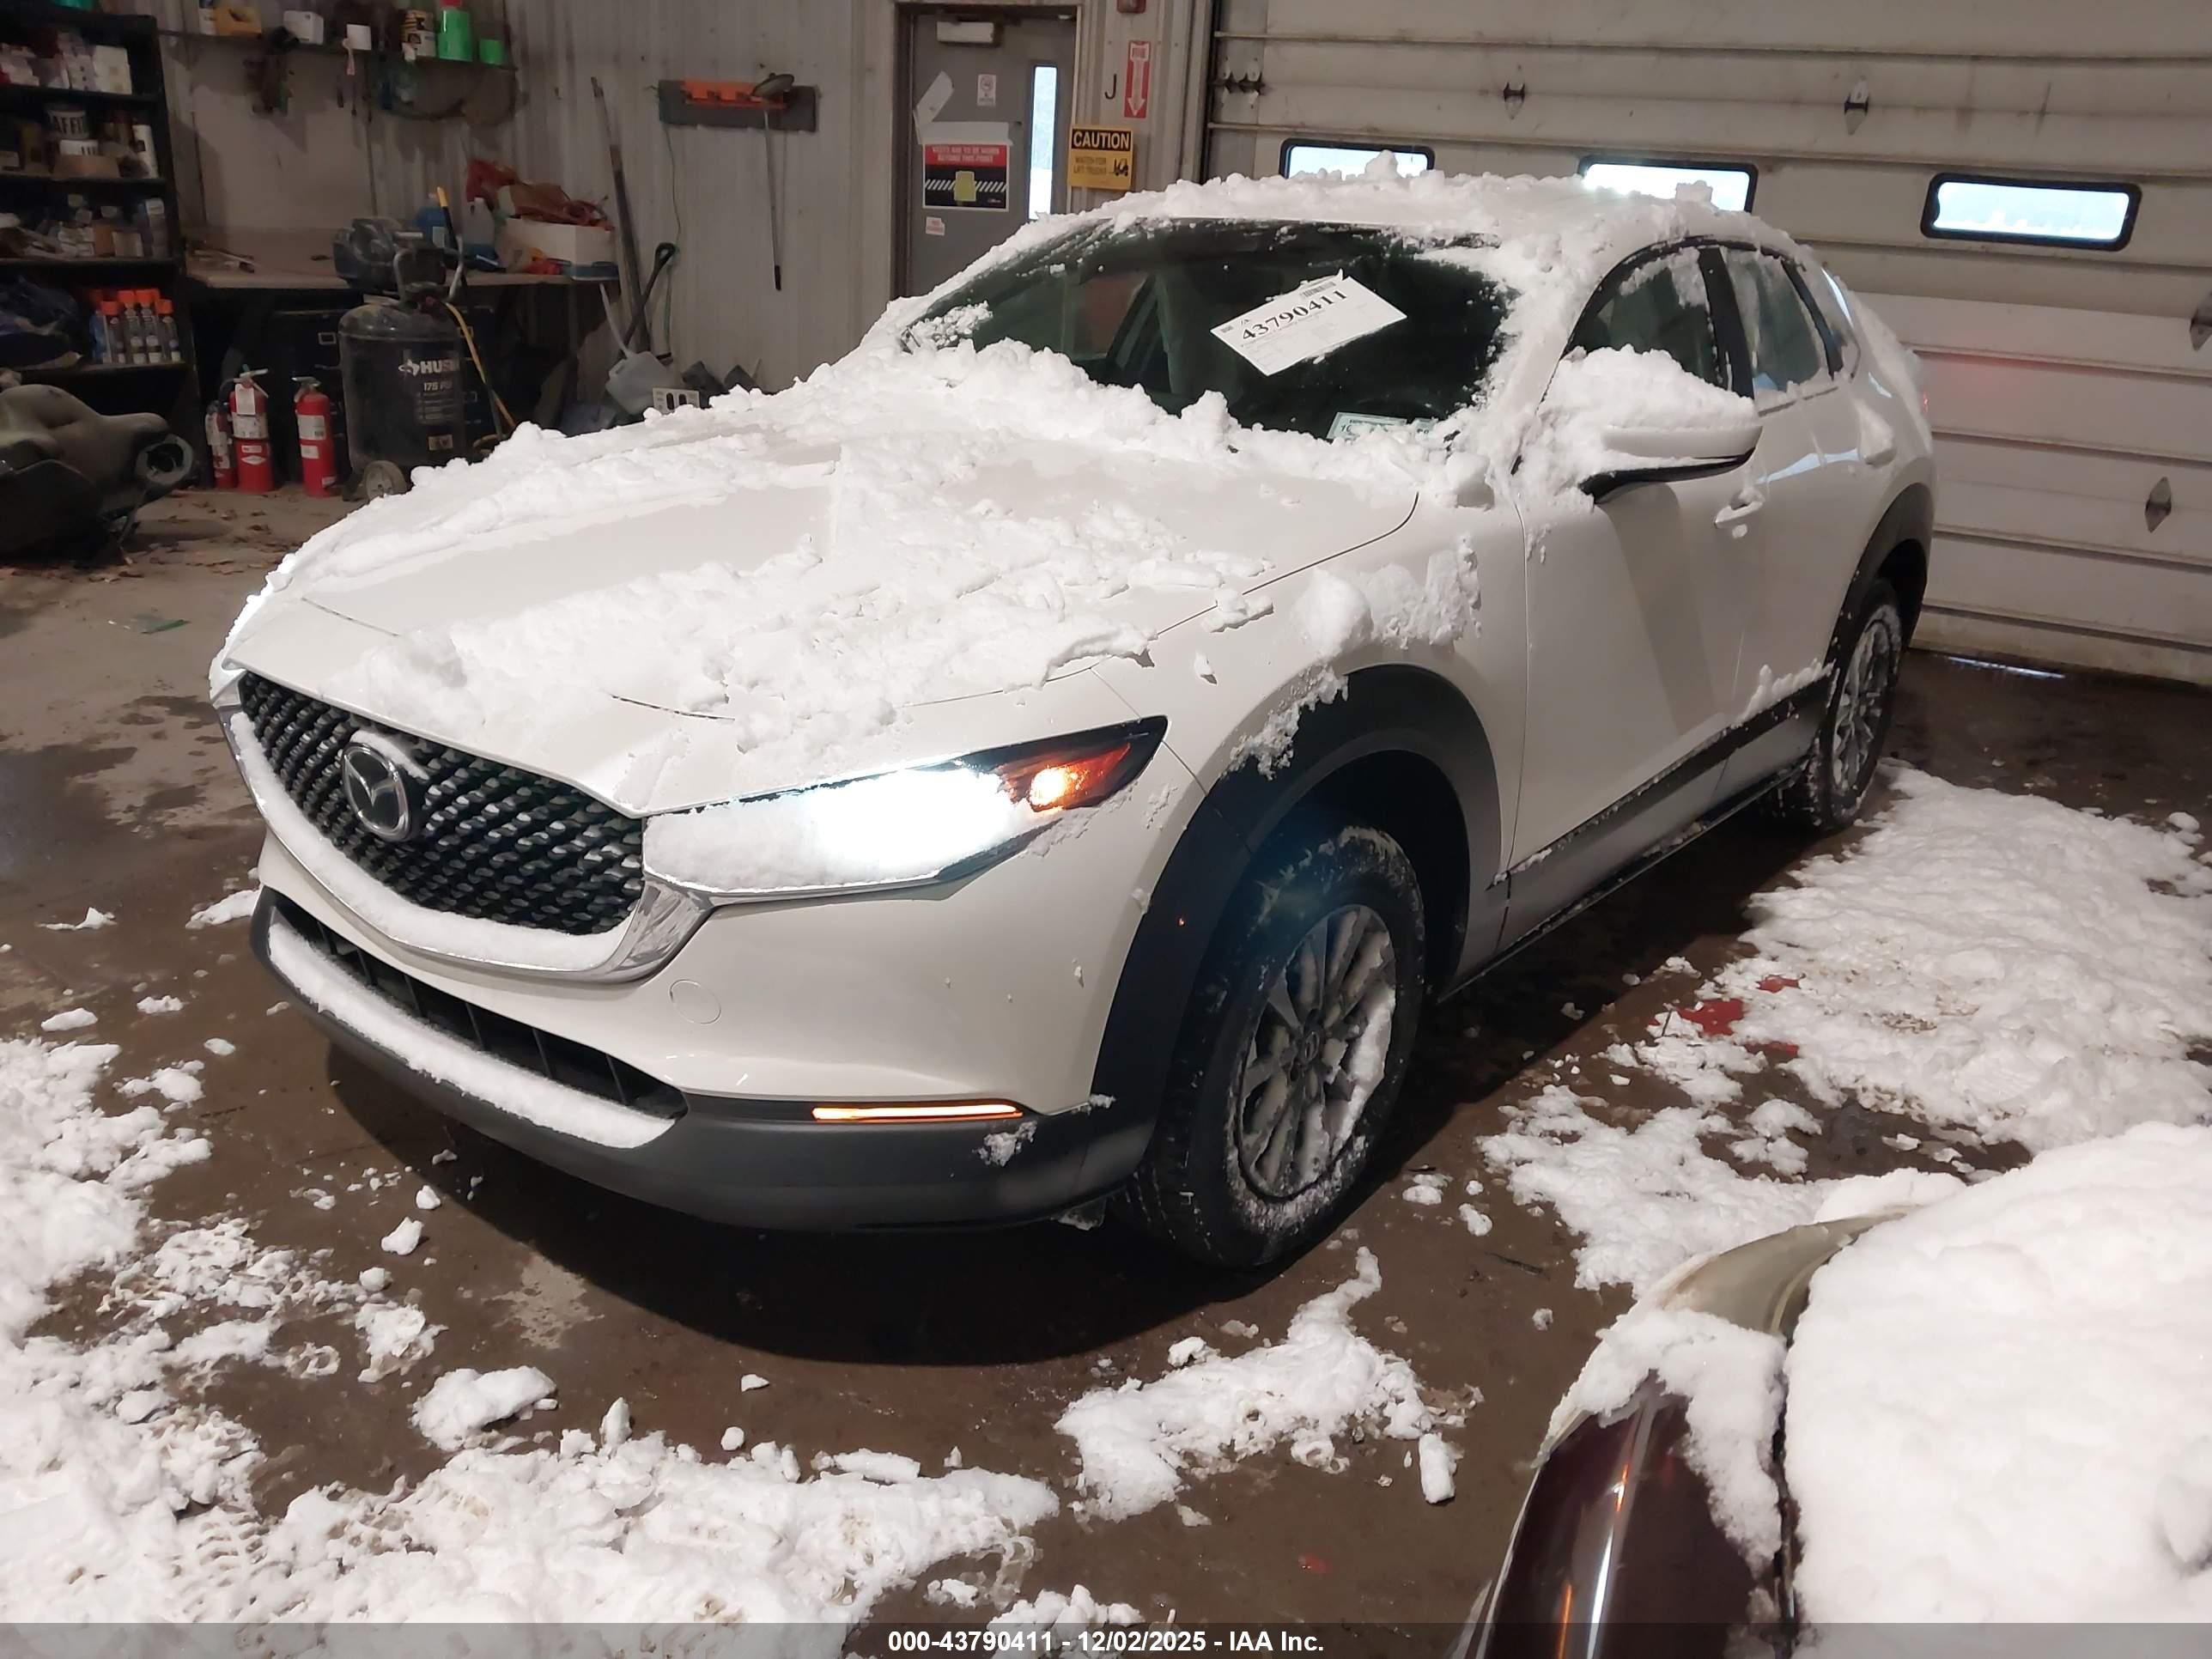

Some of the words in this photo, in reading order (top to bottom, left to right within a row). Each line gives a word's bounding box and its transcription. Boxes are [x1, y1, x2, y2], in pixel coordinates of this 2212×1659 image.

[1104, 74, 1117, 100] J
[1073, 131, 1130, 149] CAUTION
[1243, 290, 1347, 339] 43790411
[423, 381, 439, 392] 175
